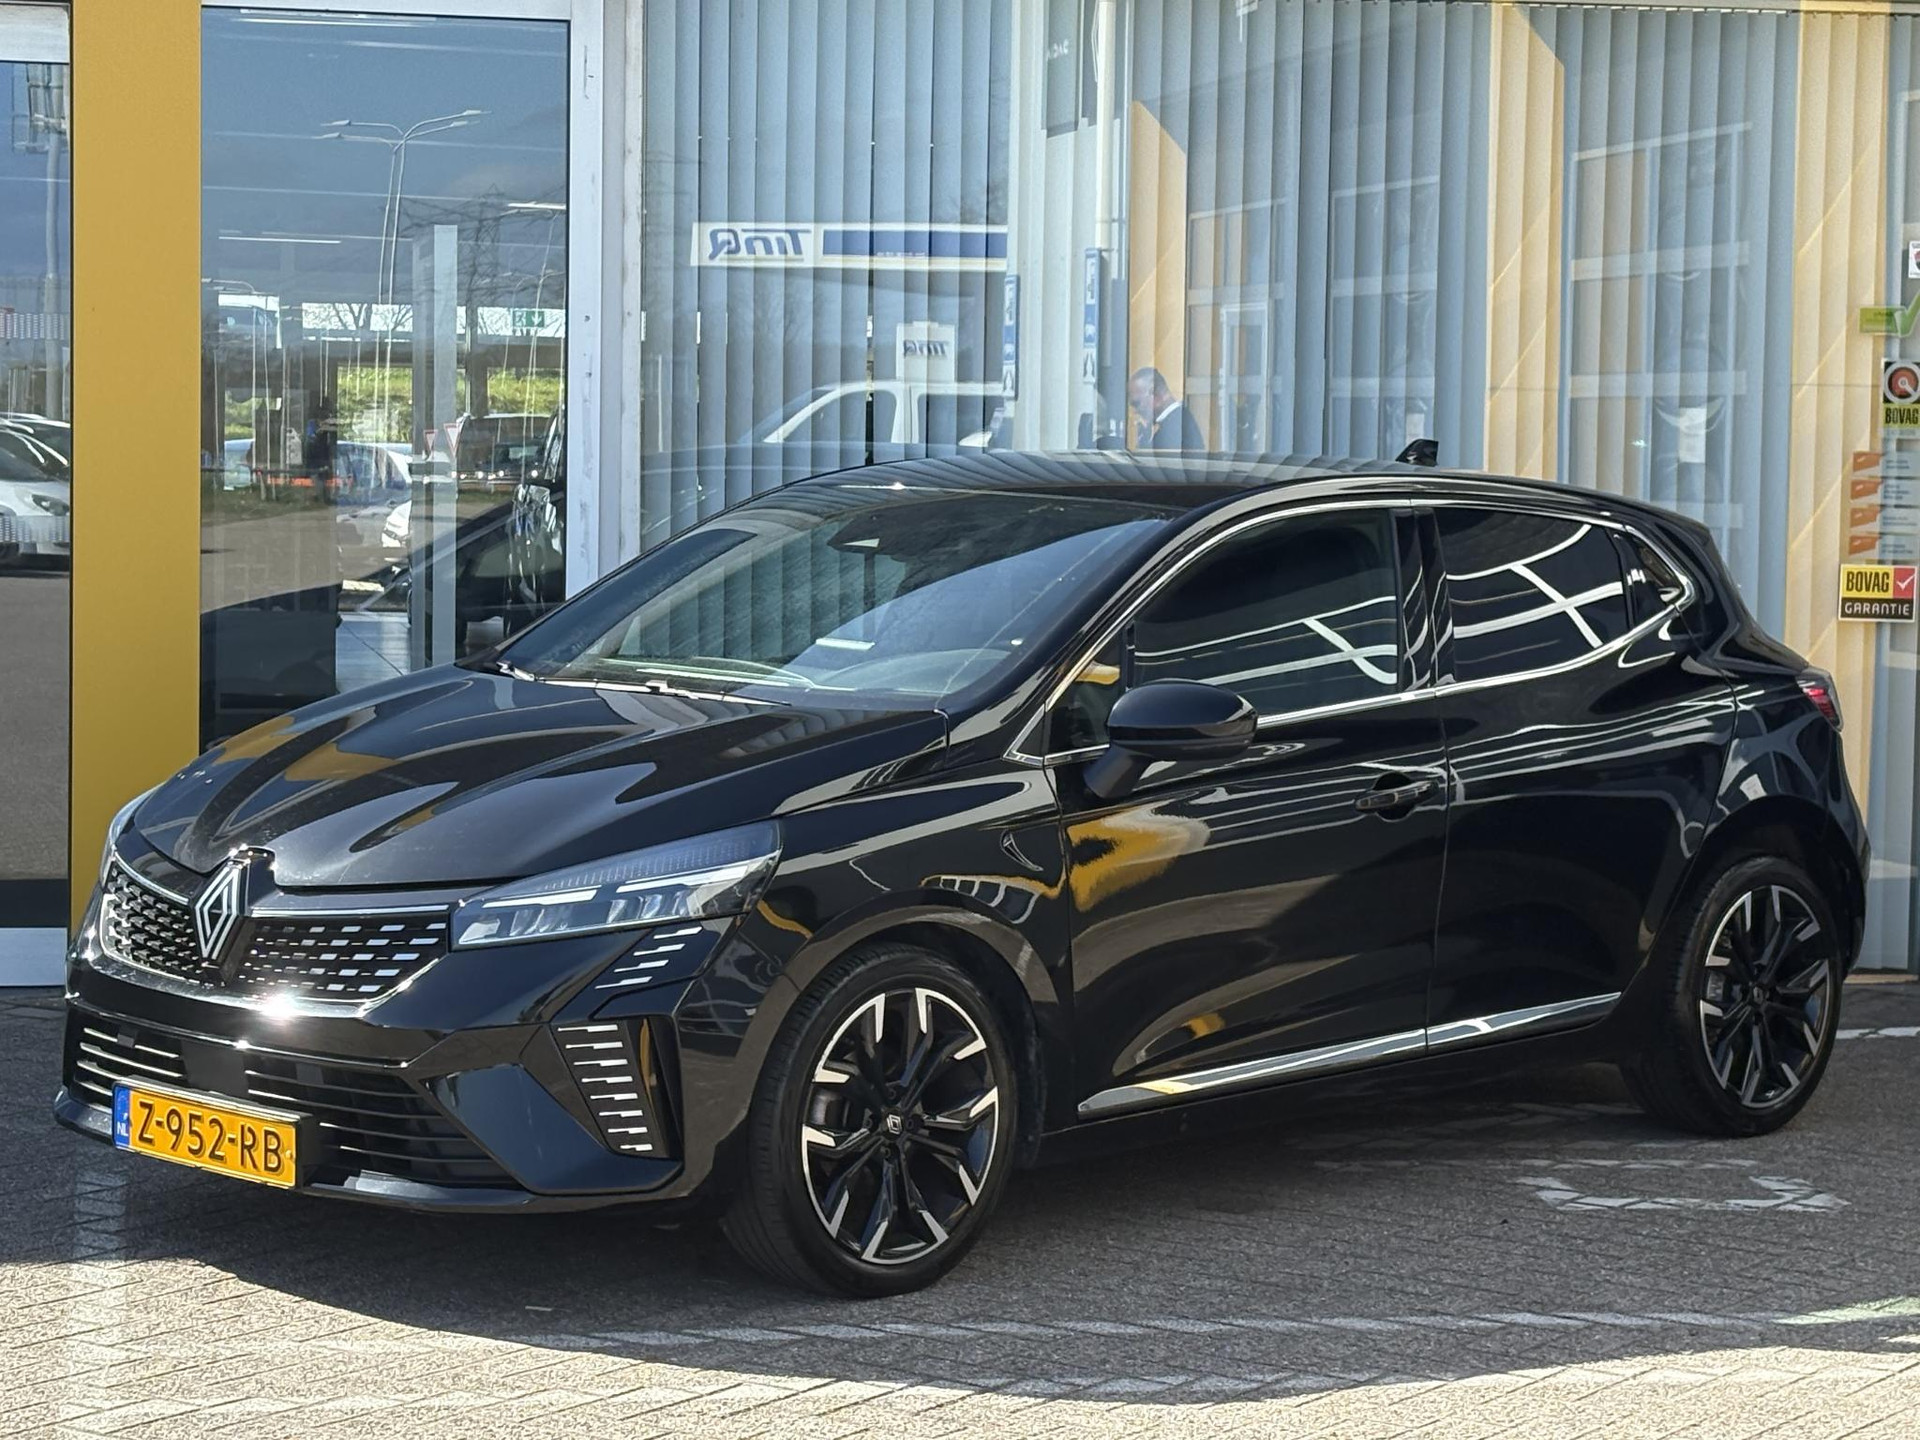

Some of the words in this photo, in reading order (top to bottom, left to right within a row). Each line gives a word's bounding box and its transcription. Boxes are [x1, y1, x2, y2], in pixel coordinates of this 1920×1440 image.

[1885, 407, 1919, 425] BOVAG
[1845, 571, 1890, 593] BOVAG
[1844, 602, 1910, 616] GARANTIE
[117, 1123, 129, 1137] NL
[138, 1101, 282, 1173] Z-952-RB
